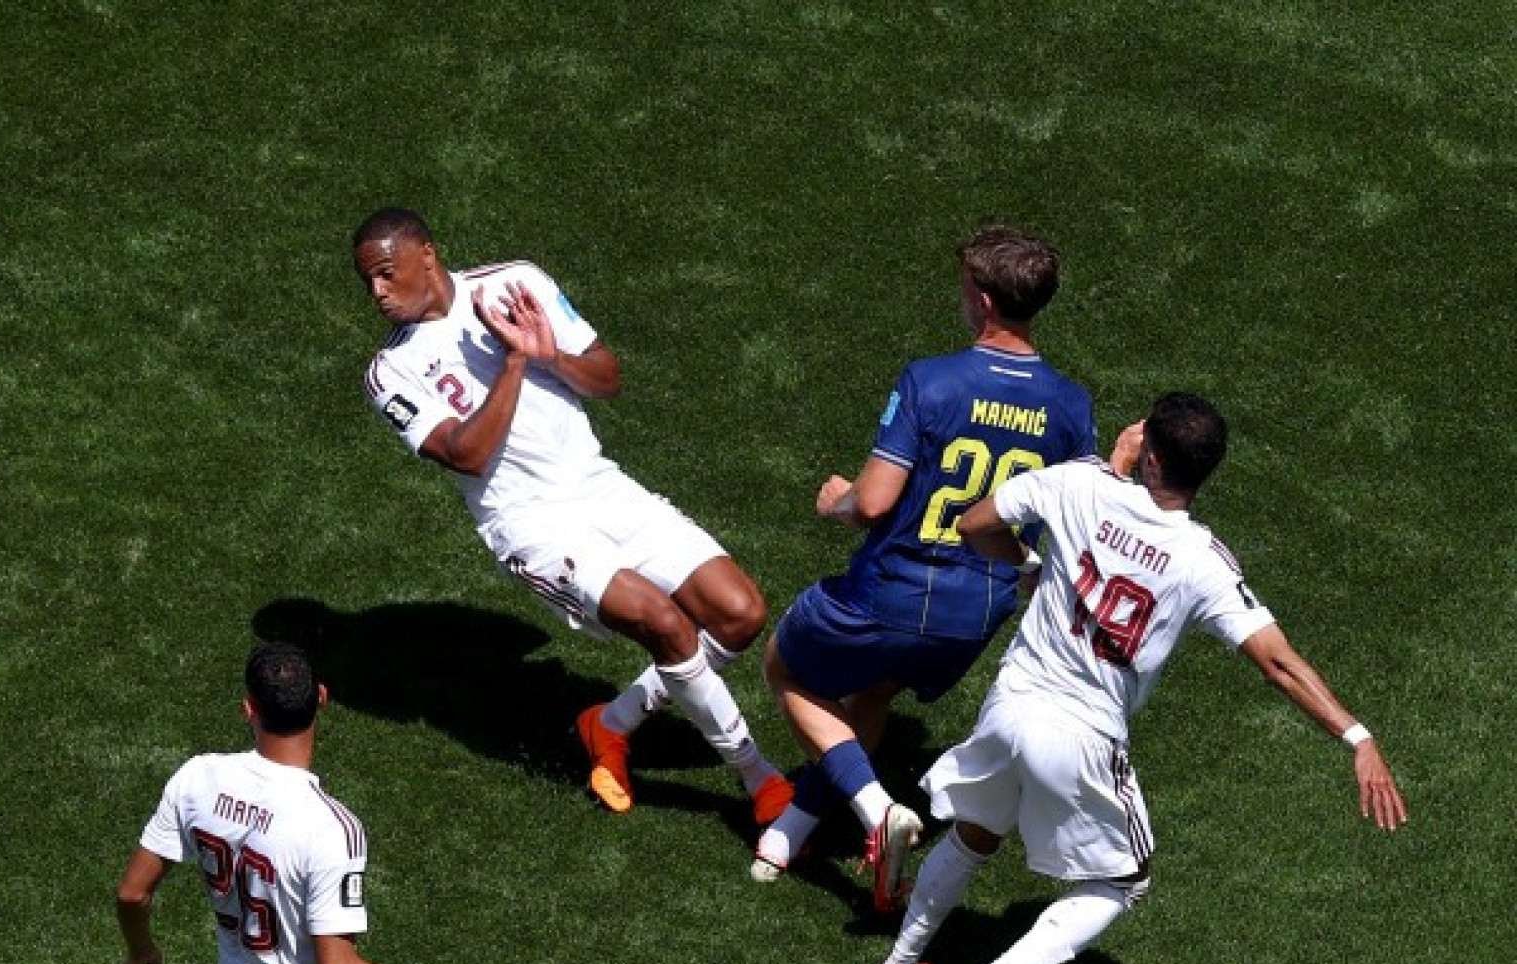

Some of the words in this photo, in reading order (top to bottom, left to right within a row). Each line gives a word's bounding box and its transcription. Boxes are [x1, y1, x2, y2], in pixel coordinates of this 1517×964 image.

[435, 372, 473, 416] 2
[970, 398, 1048, 437] MAHMIĆ
[1095, 519, 1172, 576] SULTAN
[1069, 549, 1158, 666] 19
[212, 792, 274, 835] MANAI
[190, 826, 279, 951] 26
